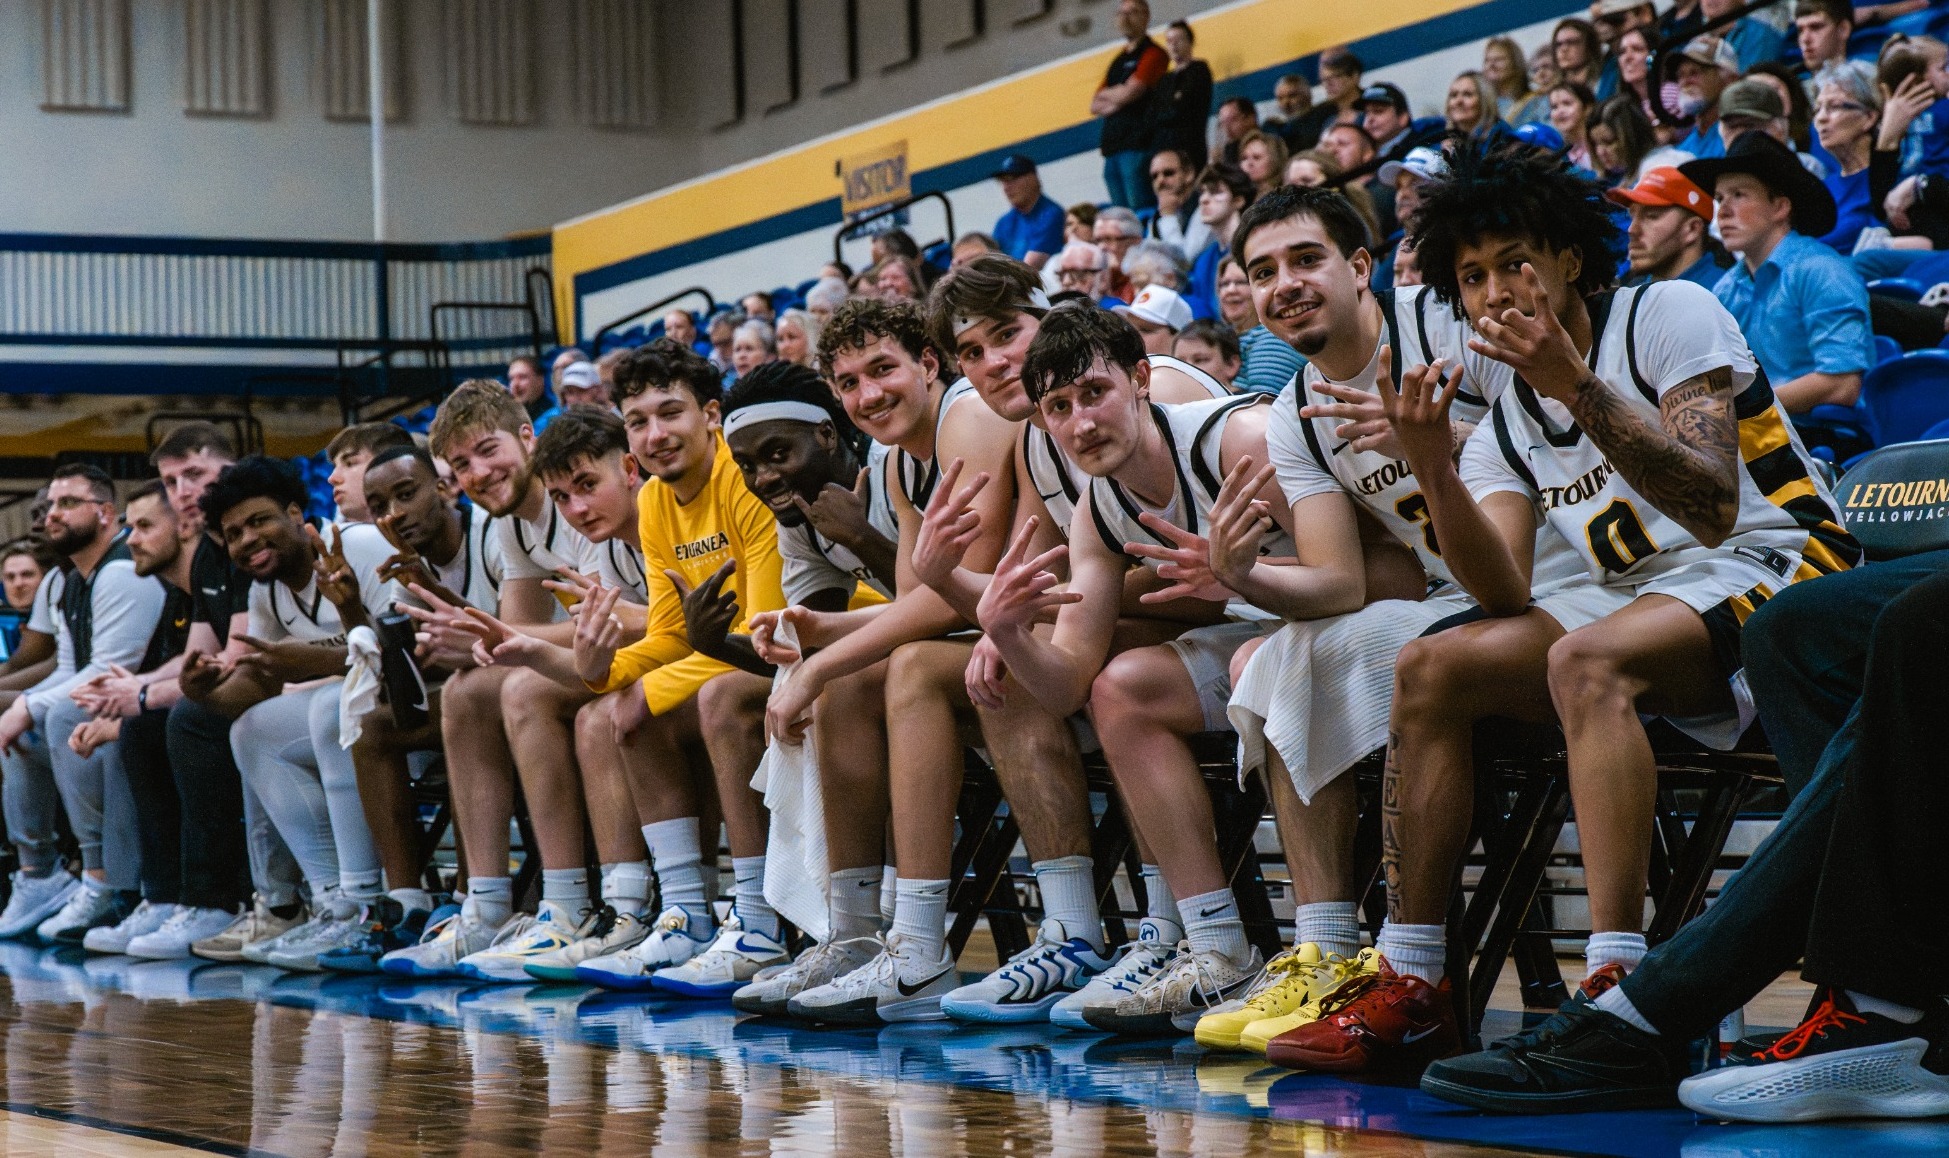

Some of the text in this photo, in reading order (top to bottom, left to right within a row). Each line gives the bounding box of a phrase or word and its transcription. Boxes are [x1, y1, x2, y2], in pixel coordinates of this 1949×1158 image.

[1845, 478, 1949, 508] LETOURN
[1845, 506, 1949, 523] YELLOWJAC
[1583, 496, 1661, 574] 0
